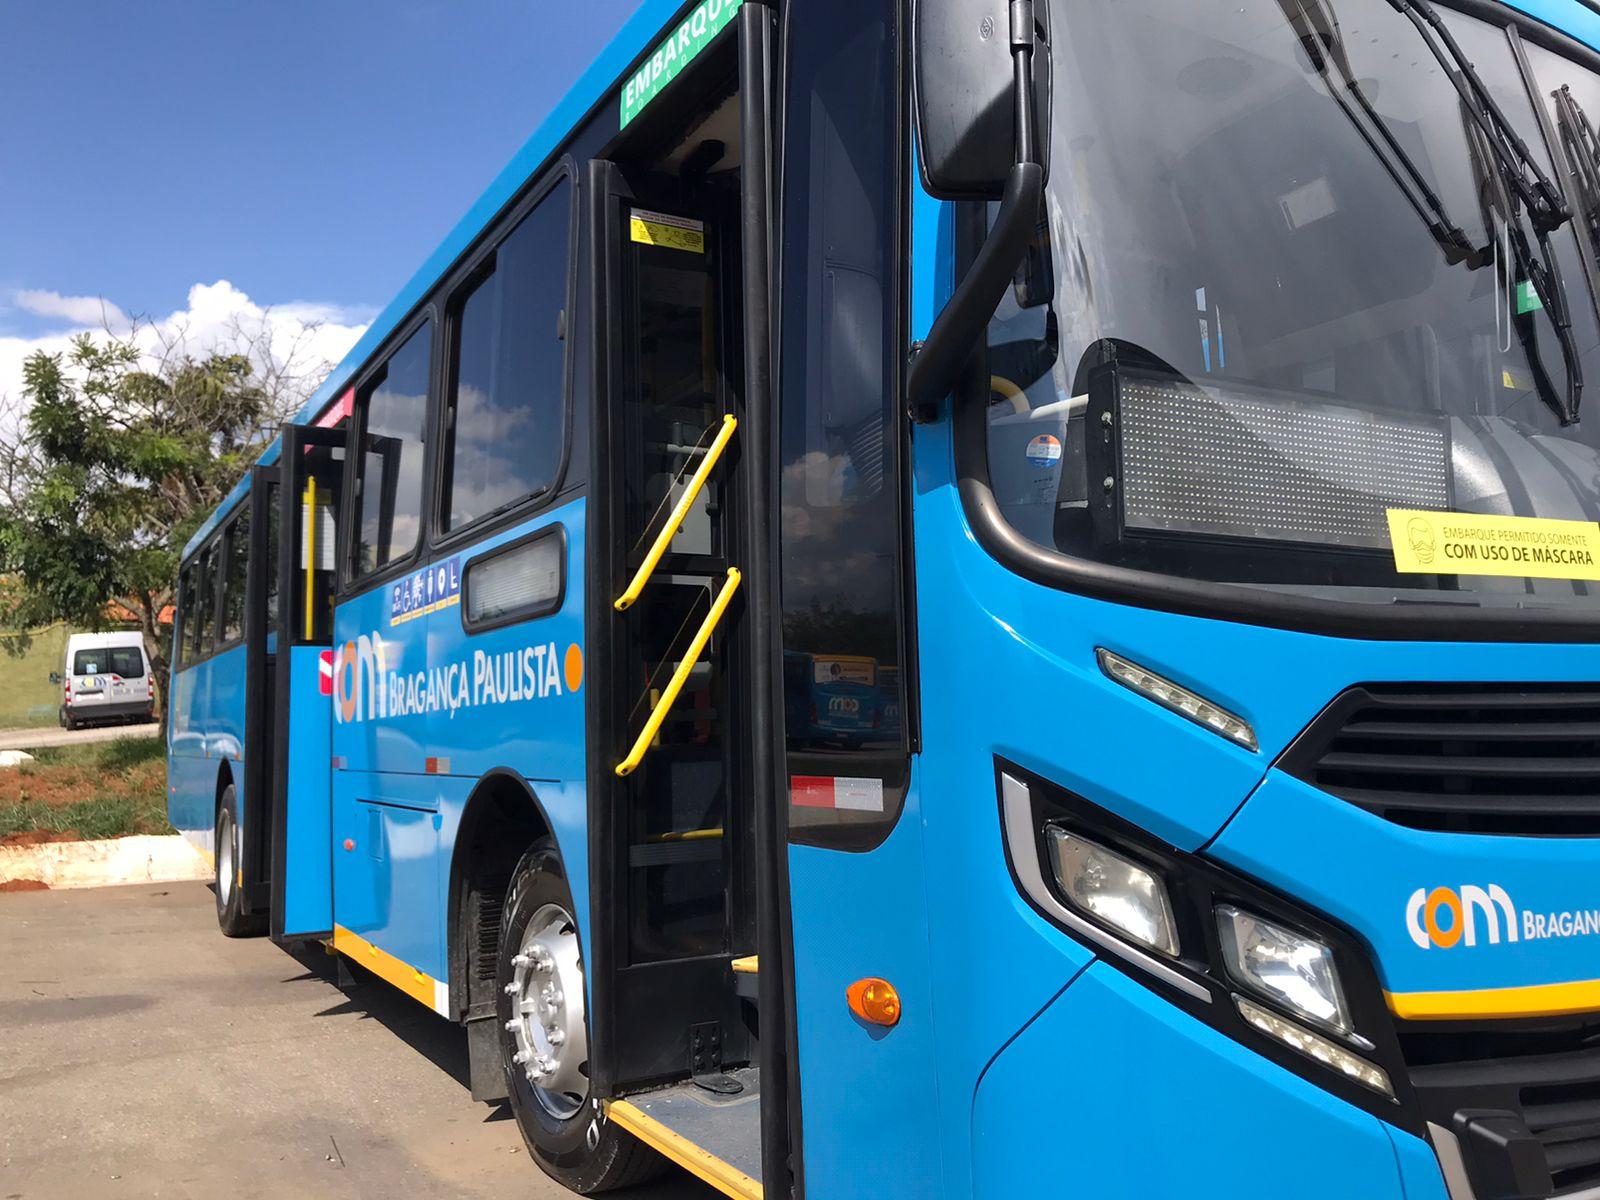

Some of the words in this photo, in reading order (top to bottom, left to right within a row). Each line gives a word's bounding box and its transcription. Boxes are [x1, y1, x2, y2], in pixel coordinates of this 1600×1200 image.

[625, 0, 733, 109] EMBARQU
[1443, 526, 1498, 541] EMBARQUE
[1498, 530, 1547, 544] PERMITIDO
[1547, 533, 1588, 547] SOMENTE
[1444, 543, 1478, 560] COM
[1480, 545, 1509, 561] USO
[1512, 548, 1531, 562] DE
[1533, 545, 1594, 566] MÁSCARA
[389, 660, 470, 719] BRAGANÇA
[474, 642, 563, 706] PAULISTA
[1522, 909, 1600, 940] BRAGAN
